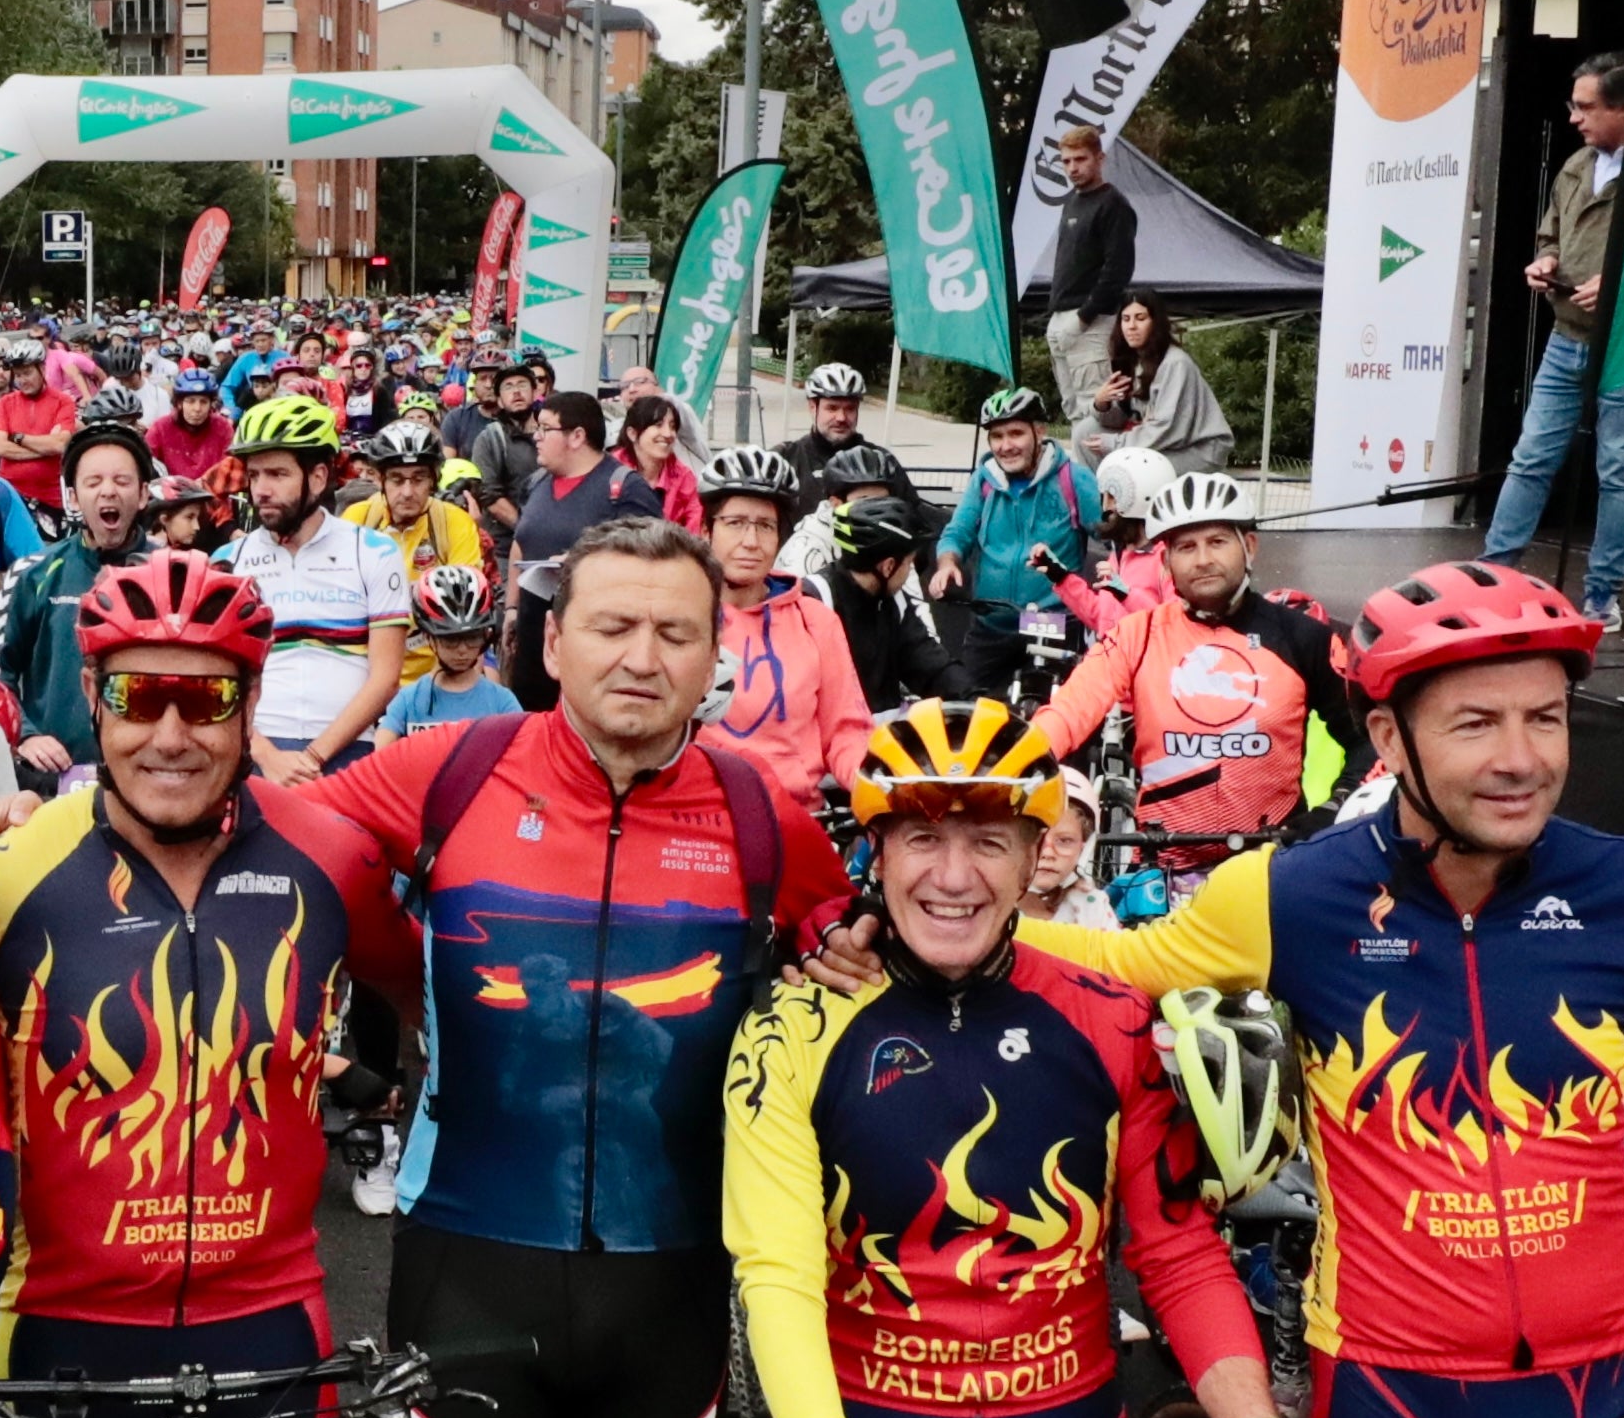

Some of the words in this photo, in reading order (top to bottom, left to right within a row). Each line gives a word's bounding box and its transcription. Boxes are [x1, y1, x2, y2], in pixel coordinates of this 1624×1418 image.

[1399, 22, 1467, 67] Valladolid
[1414, 153, 1459, 181] Castilla
[679, 195, 751, 325] Inglés
[1163, 730, 1272, 760] IVECO
[661, 847, 710, 862] AMIGOS
[715, 852, 730, 864] DE
[693, 862, 730, 874] NEGRO
[127, 1191, 254, 1219] TRIATLÓN
[1424, 1180, 1569, 1215] TRIATLÓN
[123, 1218, 255, 1245] BOMBEROS
[1426, 1208, 1570, 1239] BOMBEROS
[140, 1248, 236, 1265] VALLADOLID
[1439, 1233, 1567, 1259] VALLADOLID
[872, 1315, 1075, 1365] BOMBEROS
[861, 1348, 1080, 1403] VALLADOLID
